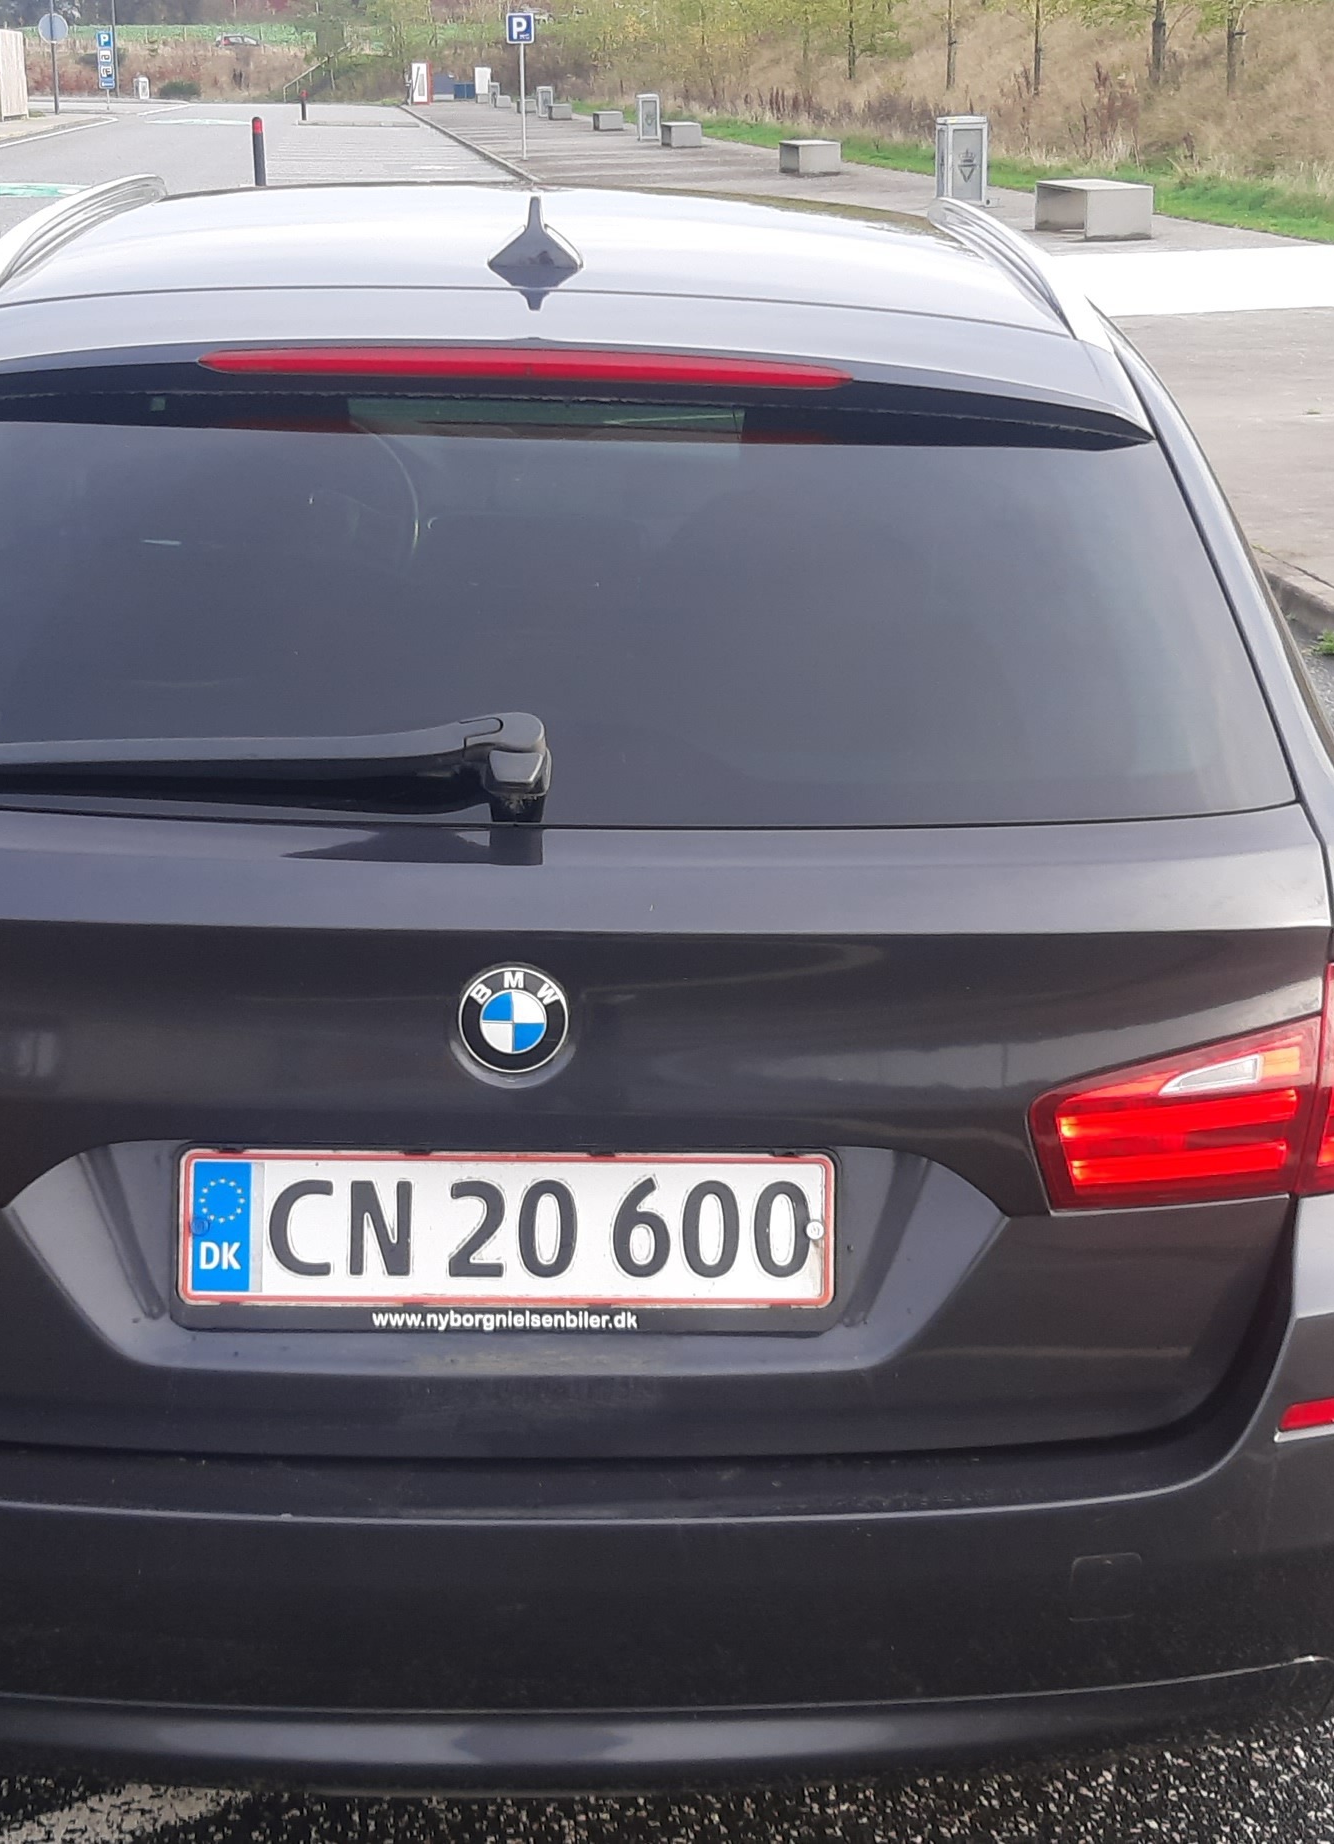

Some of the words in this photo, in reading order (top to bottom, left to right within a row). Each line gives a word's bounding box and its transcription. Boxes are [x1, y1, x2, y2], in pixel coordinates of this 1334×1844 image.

[100, 33, 109, 46] P
[512, 16, 527, 40] P
[470, 971, 560, 1006] BMW
[268, 1178, 413, 1277] CN
[448, 1178, 579, 1278] 20
[612, 1174, 812, 1279] 600
[199, 1241, 242, 1270] DK
[372, 1310, 638, 1331] www.nyborgnielsenbiler.dk
